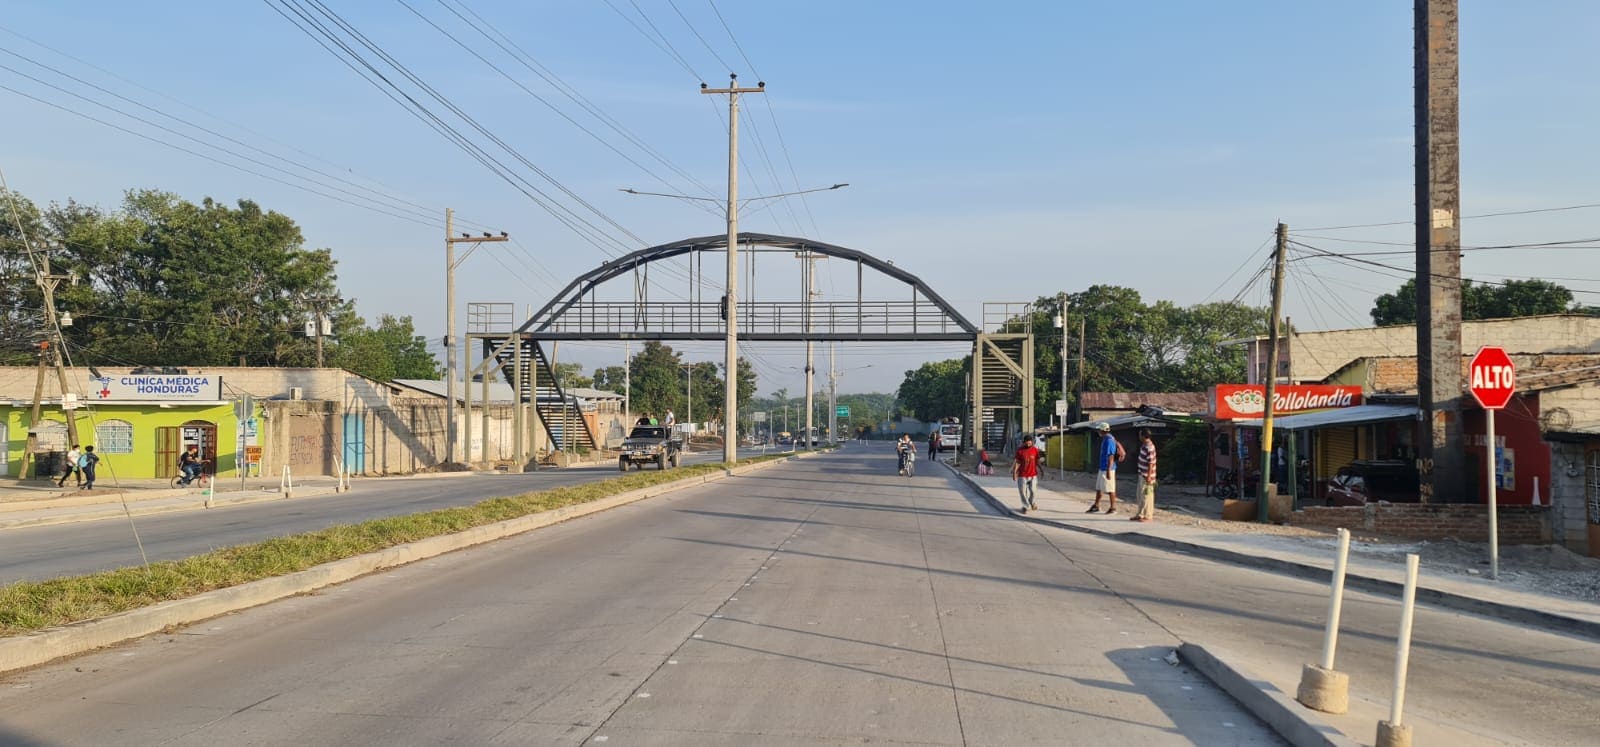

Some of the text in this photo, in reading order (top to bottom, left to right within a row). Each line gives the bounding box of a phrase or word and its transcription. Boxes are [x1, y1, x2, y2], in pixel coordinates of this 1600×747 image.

[166, 376, 209, 385] MÉDICA
[1473, 365, 1512, 389] ALTO
[138, 385, 199, 394] HONDURAS
[1272, 388, 1352, 411] Pollolandia
